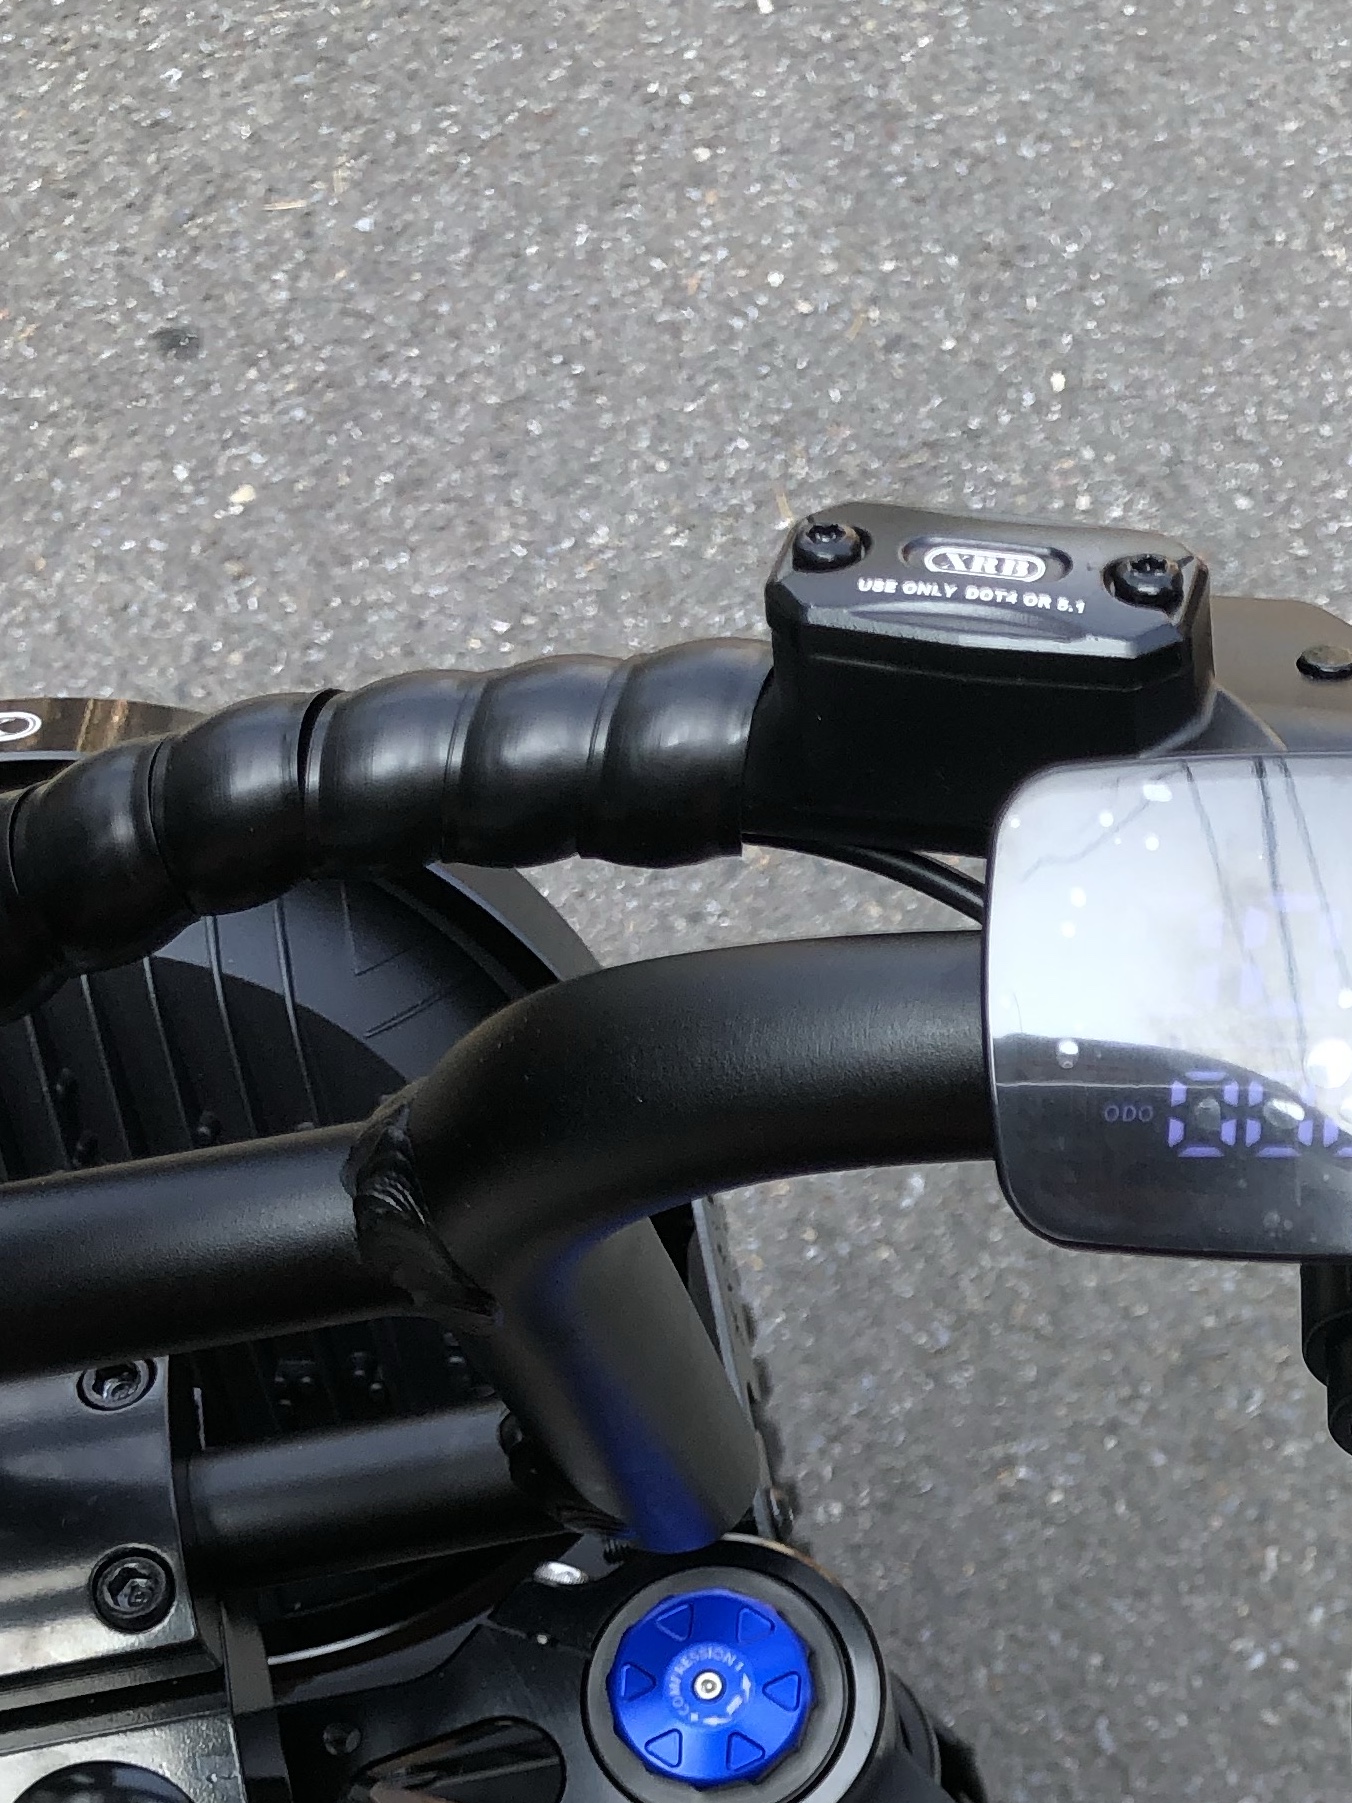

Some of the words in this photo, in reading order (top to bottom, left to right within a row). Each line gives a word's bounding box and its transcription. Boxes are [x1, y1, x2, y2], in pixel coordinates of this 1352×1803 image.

[857, 577, 898, 594] USE
[902, 580, 958, 599] ONLY
[964, 584, 1018, 605] DOT4
[1022, 591, 1052, 609] OR
[1056, 596, 1086, 614] 5.1
[1104, 1104, 1154, 1123] ODO
